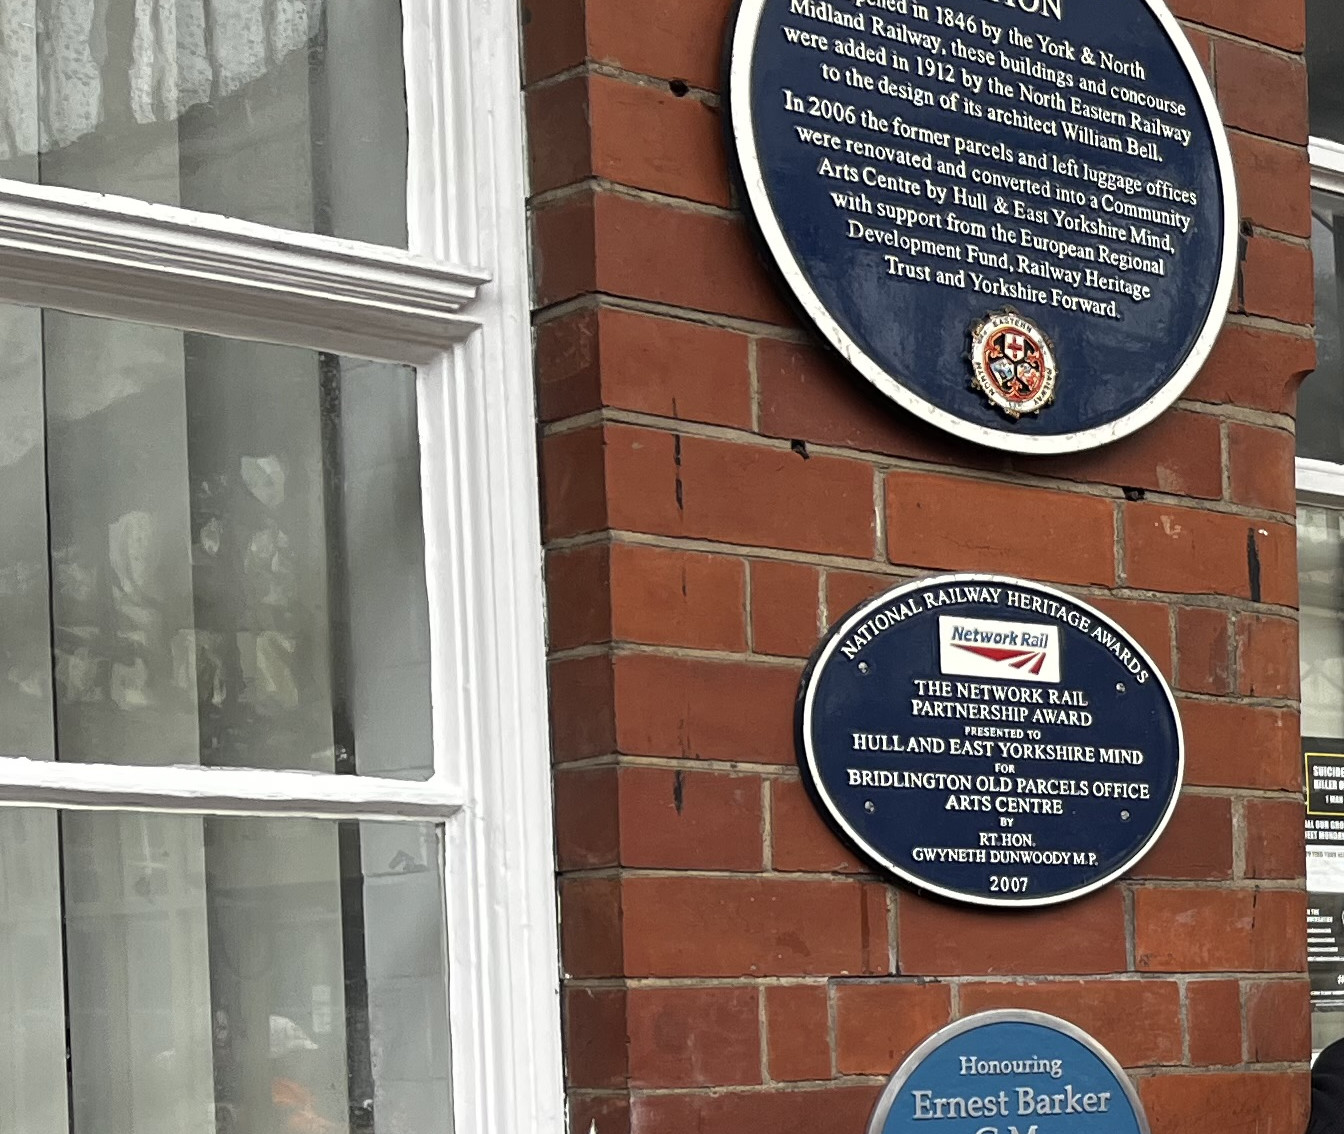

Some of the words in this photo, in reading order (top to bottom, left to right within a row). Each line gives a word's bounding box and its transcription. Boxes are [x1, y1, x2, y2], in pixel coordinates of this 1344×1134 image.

[913, 2, 929, 21] in
[937, 6, 977, 34] 1846
[982, 19, 1001, 44] by
[1009, 27, 1033, 49] the
[1036, 33, 1076, 61] York
[1081, 47, 1096, 65] &
[1099, 50, 1146, 80] North
[790, 0, 865, 31] Midland
[871, 16, 946, 55] Railway,
[951, 39, 995, 66] these
[1000, 51, 1073, 87] buildings
[1079, 77, 1106, 96] and
[1111, 86, 1186, 116] concourse
[783, 26, 828, 50] were
[835, 38, 887, 66] added
[893, 51, 909, 72] in
[917, 57, 956, 82] 1912
[962, 68, 982, 93] by
[988, 77, 1013, 98] the
[1018, 83, 1066, 112] North
[1070, 97, 1126, 126] Eastern
[1129, 111, 1191, 146] Railway
[821, 63, 840, 81] to
[846, 67, 873, 90] the
[878, 76, 934, 107] design
[940, 92, 959, 111] of
[963, 98, 982, 117] its
[987, 105, 1057, 136] architect
[1061, 121, 1122, 152] William
[1126, 137, 1163, 162] Bell.
[782, 89, 805, 112] In
[808, 97, 856, 125] 2006
[861, 109, 888, 132] the
[892, 117, 950, 148] former
[955, 135, 1013, 162] parcels
[1018, 151, 1047, 170] and
[1053, 155, 1079, 179] left
[1084, 165, 1141, 194] luggage
[1146, 180, 1197, 205] offices
[795, 126, 841, 150] were
[846, 139, 932, 170] renovated
[937, 160, 966, 179] and
[972, 169, 1050, 197] converted
[1056, 184, 1085, 205] into
[1090, 195, 1098, 209] a
[1101, 194, 1190, 233] Community
[819, 157, 858, 182] Arts
[863, 168, 920, 196] Centre
[926, 180, 947, 204] by
[953, 186, 987, 211] Hull
[994, 197, 1009, 214] &
[1013, 200, 1048, 224] East
[1051, 208, 1126, 240] Yorkshire
[1130, 226, 1175, 253] Mind,
[831, 191, 872, 214] with
[877, 203, 942, 228] support
[947, 212, 986, 238] from
[991, 223, 1016, 243] the
[1020, 229, 1094, 261] European
[1098, 246, 1164, 275] Regional
[847, 220, 961, 260] Development
[966, 244, 1014, 273] Fund,
[1016, 255, 1081, 287] Railway
[1084, 269, 1150, 300] Heritage
[884, 254, 931, 281] Trust
[936, 270, 965, 288] and
[968, 272, 1047, 303] Yorkshire
[1051, 289, 1121, 318] Forward.
[841, 599, 922, 660] NATIONAL
[923, 587, 1001, 609] RAILWAY
[1007, 591, 1091, 632] HERITAGE
[1091, 626, 1149, 684] AWARDS
[952, 626, 1018, 645] Network
[1020, 632, 1048, 649] Rail
[914, 680, 952, 697] THE
[957, 682, 1045, 704] NETWORK
[1048, 689, 1088, 707] RAIL
[912, 699, 1028, 722] PARTNERSHIP
[1032, 708, 1092, 727] AWARD
[964, 726, 1023, 739] PRESENTED
[1027, 729, 1041, 739] TO
[853, 734, 904, 751] HULL
[907, 736, 945, 754] AND
[949, 739, 994, 757] EAST
[998, 742, 1095, 763] YORKSHIRE
[1099, 748, 1143, 765] MIND
[847, 769, 971, 793] BRIDLINGTON
[976, 776, 1012, 793] OLD
[1016, 778, 1088, 797] PARCELS
[1092, 782, 1149, 799] OFFICE
[995, 763, 1015, 774] FOR
[1313, 765, 1344, 777] SUICIDE
[945, 795, 991, 811] ARTS
[995, 797, 1063, 814] CENTRE
[999, 817, 1014, 827] BY
[913, 847, 985, 863] GWYNETH
[990, 850, 1071, 865] DUNWOODY
[1073, 852, 1099, 866] M.P.
[989, 876, 1028, 892] 2007
[959, 1054, 1062, 1078] Honouring
[911, 1090, 1009, 1119] Ernest
[1015, 1084, 1111, 1115] Barker
